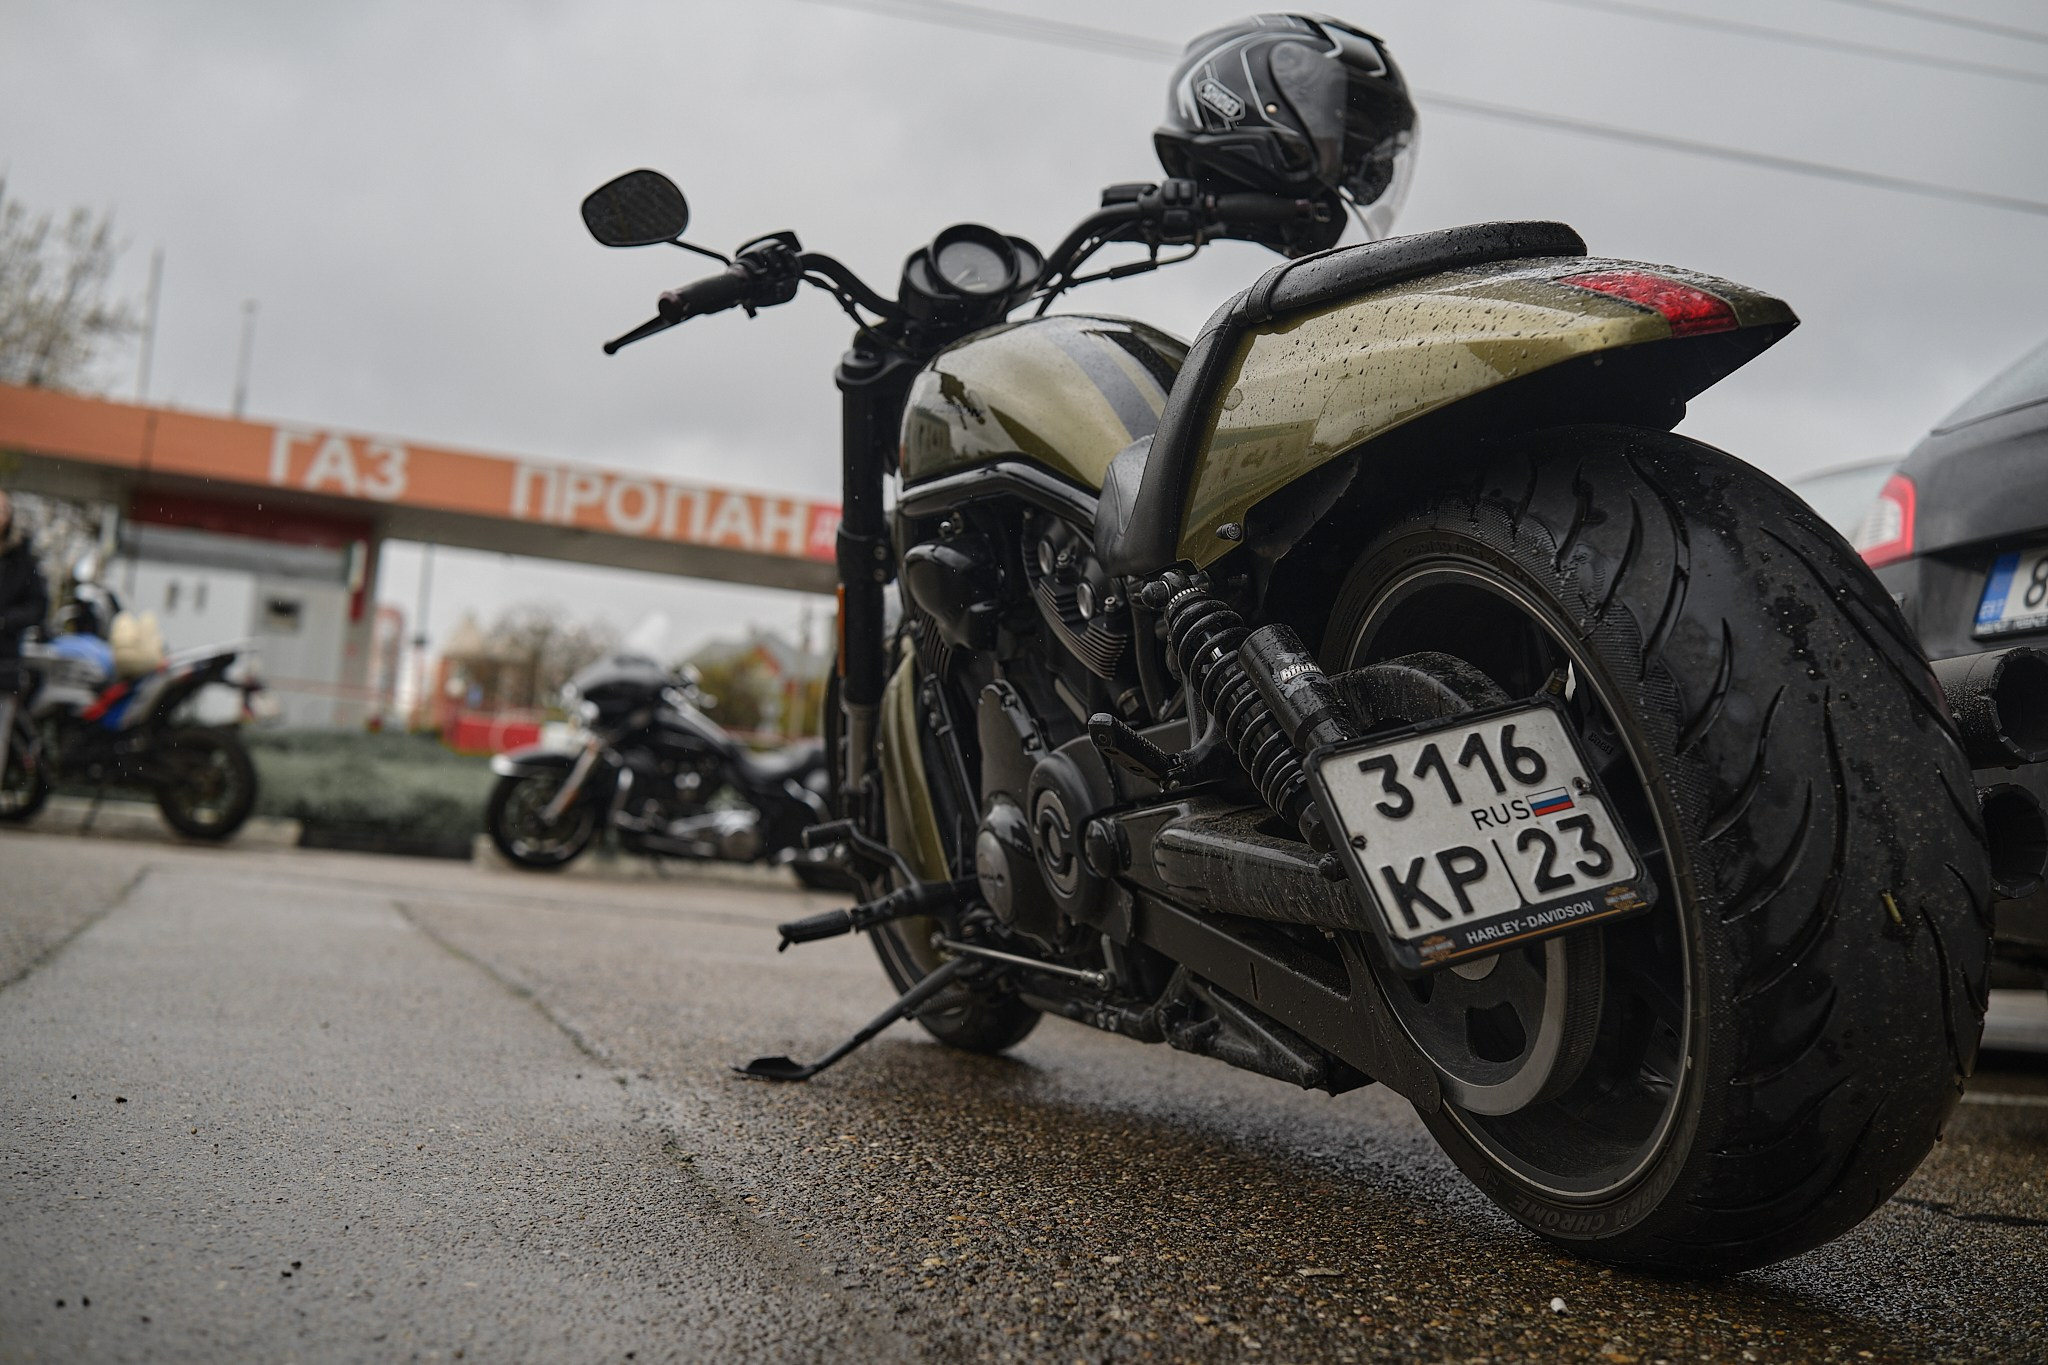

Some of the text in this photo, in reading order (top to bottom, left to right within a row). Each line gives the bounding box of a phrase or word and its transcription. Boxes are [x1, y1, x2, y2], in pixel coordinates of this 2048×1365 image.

[268, 427, 410, 499] ГАЗ
[509, 463, 810, 555] ПРОПАН
[1357, 724, 1547, 818] 3116
[1471, 800, 1531, 830] RUS
[1516, 813, 1613, 893] 23
[1466, 900, 1595, 944] HARLEY-DAVIDSON
